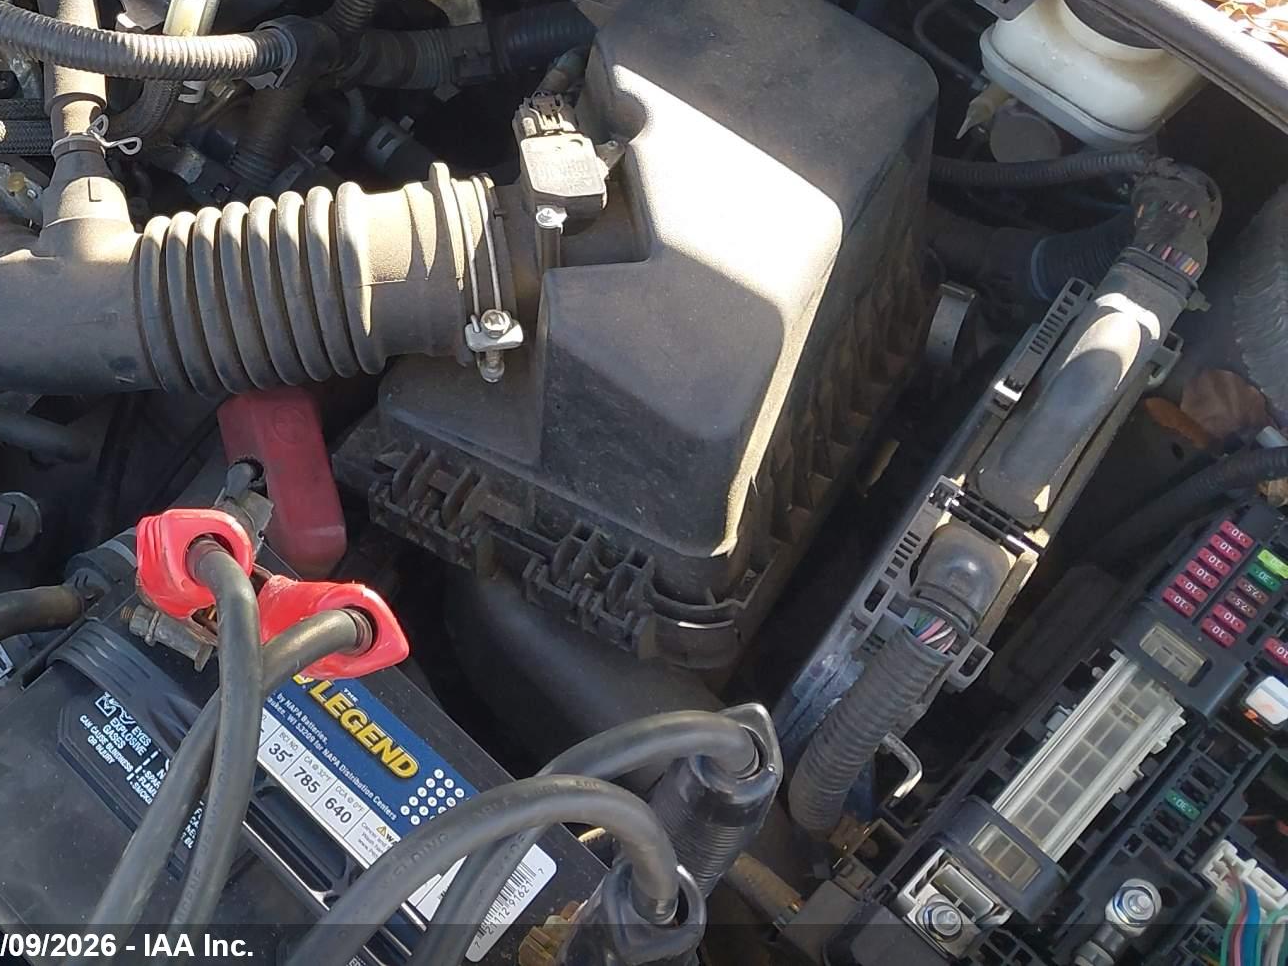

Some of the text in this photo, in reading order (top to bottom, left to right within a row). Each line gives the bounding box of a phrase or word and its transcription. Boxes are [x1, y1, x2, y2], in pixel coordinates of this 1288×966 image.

[1232, 527, 1244, 540] 10
[1220, 541, 1232, 554] 10
[1208, 554, 1221, 568] 10
[1196, 568, 1210, 580] 10
[1185, 581, 1198, 594] 10
[1174, 594, 1186, 608] 10
[1224, 611, 1236, 624] 10
[1212, 625, 1226, 638] 10
[277, 693, 286, 703] by
[286, 698, 303, 718] NAPA
[102, 724, 126, 750] GASES
[110, 717, 146, 756] EXPLOSIVE
[131, 726, 152, 746] EYES
[308, 679, 420, 779] LEGEND
[80, 715, 134, 772] CAN CAUSE BLINDNESS
[268, 743, 287, 763] 35
[286, 714, 296, 724] WI
[296, 722, 314, 744] 53209
[312, 738, 323, 752] for
[322, 746, 340, 768] NAPA
[338, 762, 374, 800] Distribution
[373, 794, 397, 822] Centers
[304, 756, 313, 765] CA
[144, 770, 162, 789] SPAR
[294, 766, 321, 793] 785
[336, 786, 348, 800] CCA
[324, 798, 352, 824] 640
[1176, 798, 1189, 812] 30
[485, 908, 510, 935] 21112
[510, 880, 533, 906] 91621
